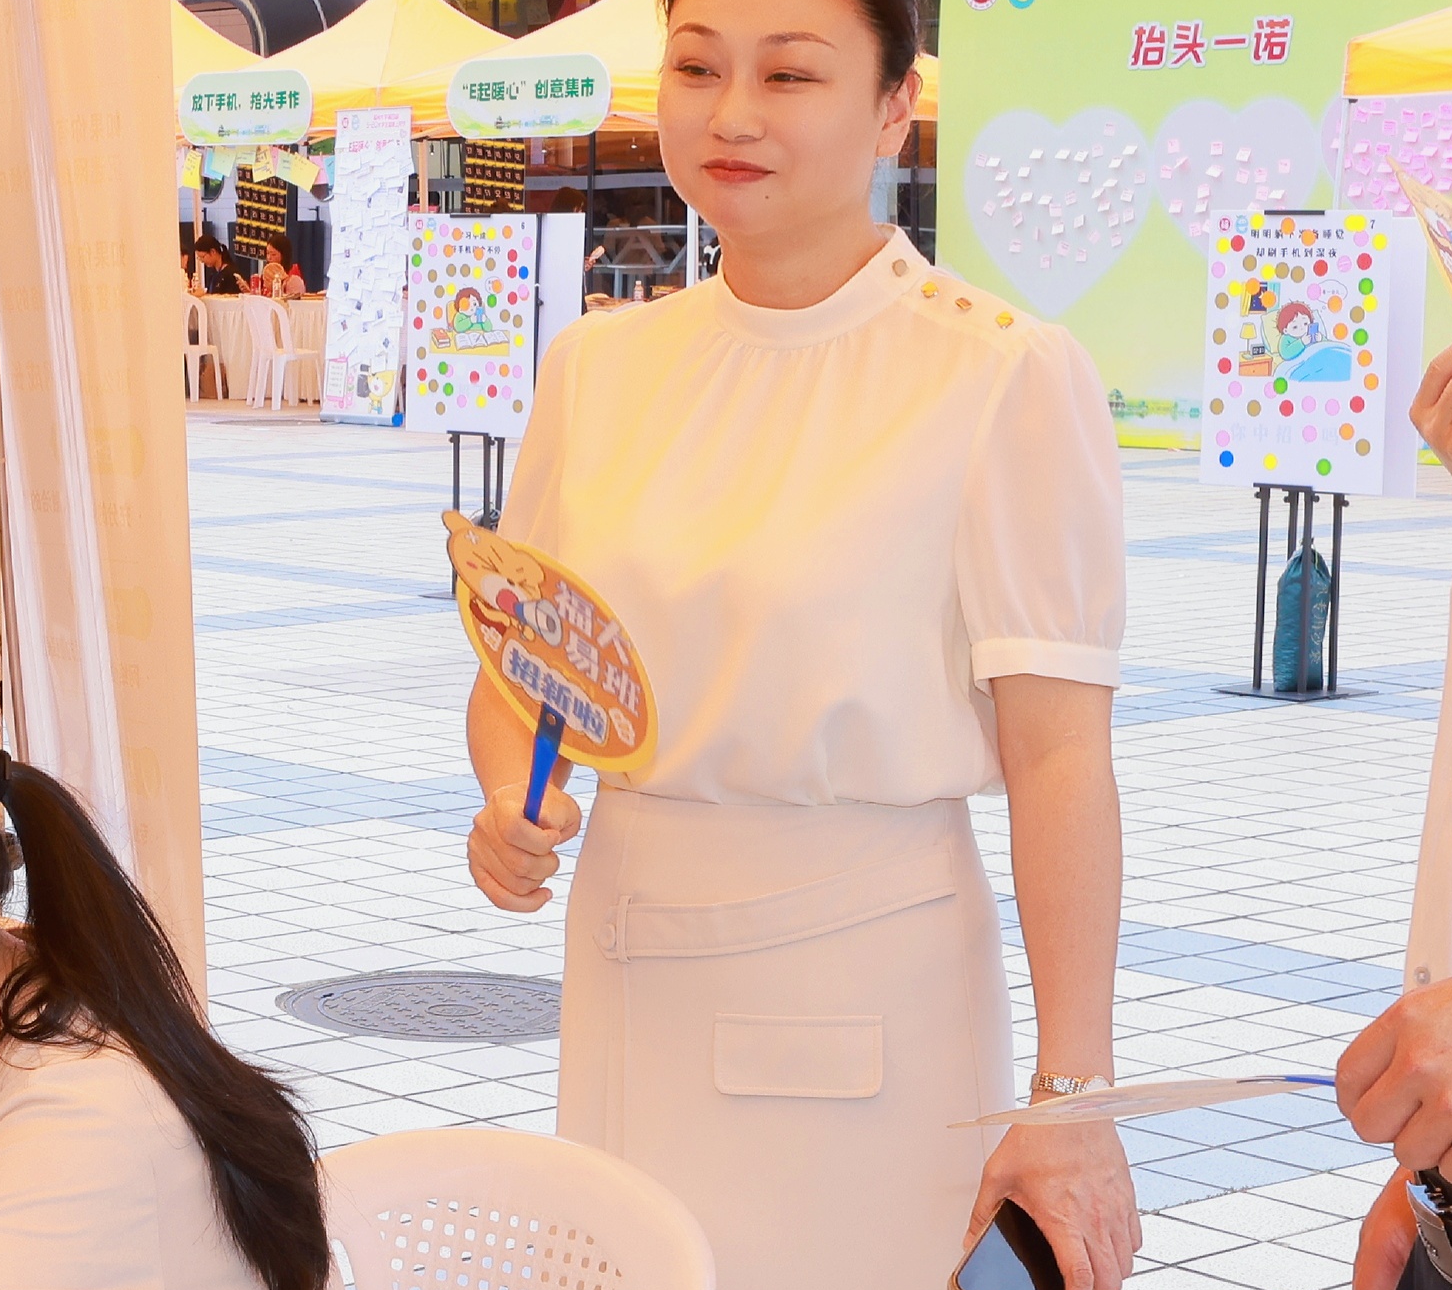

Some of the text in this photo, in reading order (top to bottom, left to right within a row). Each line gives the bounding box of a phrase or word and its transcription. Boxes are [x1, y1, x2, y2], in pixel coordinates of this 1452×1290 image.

[1129, 15, 1293, 69] 抬头一诺
[1370, 219, 1376, 230] 7
[552, 580, 634, 667] 福大
[508, 647, 608, 745] 招新啦
[563, 632, 642, 717] 易班
